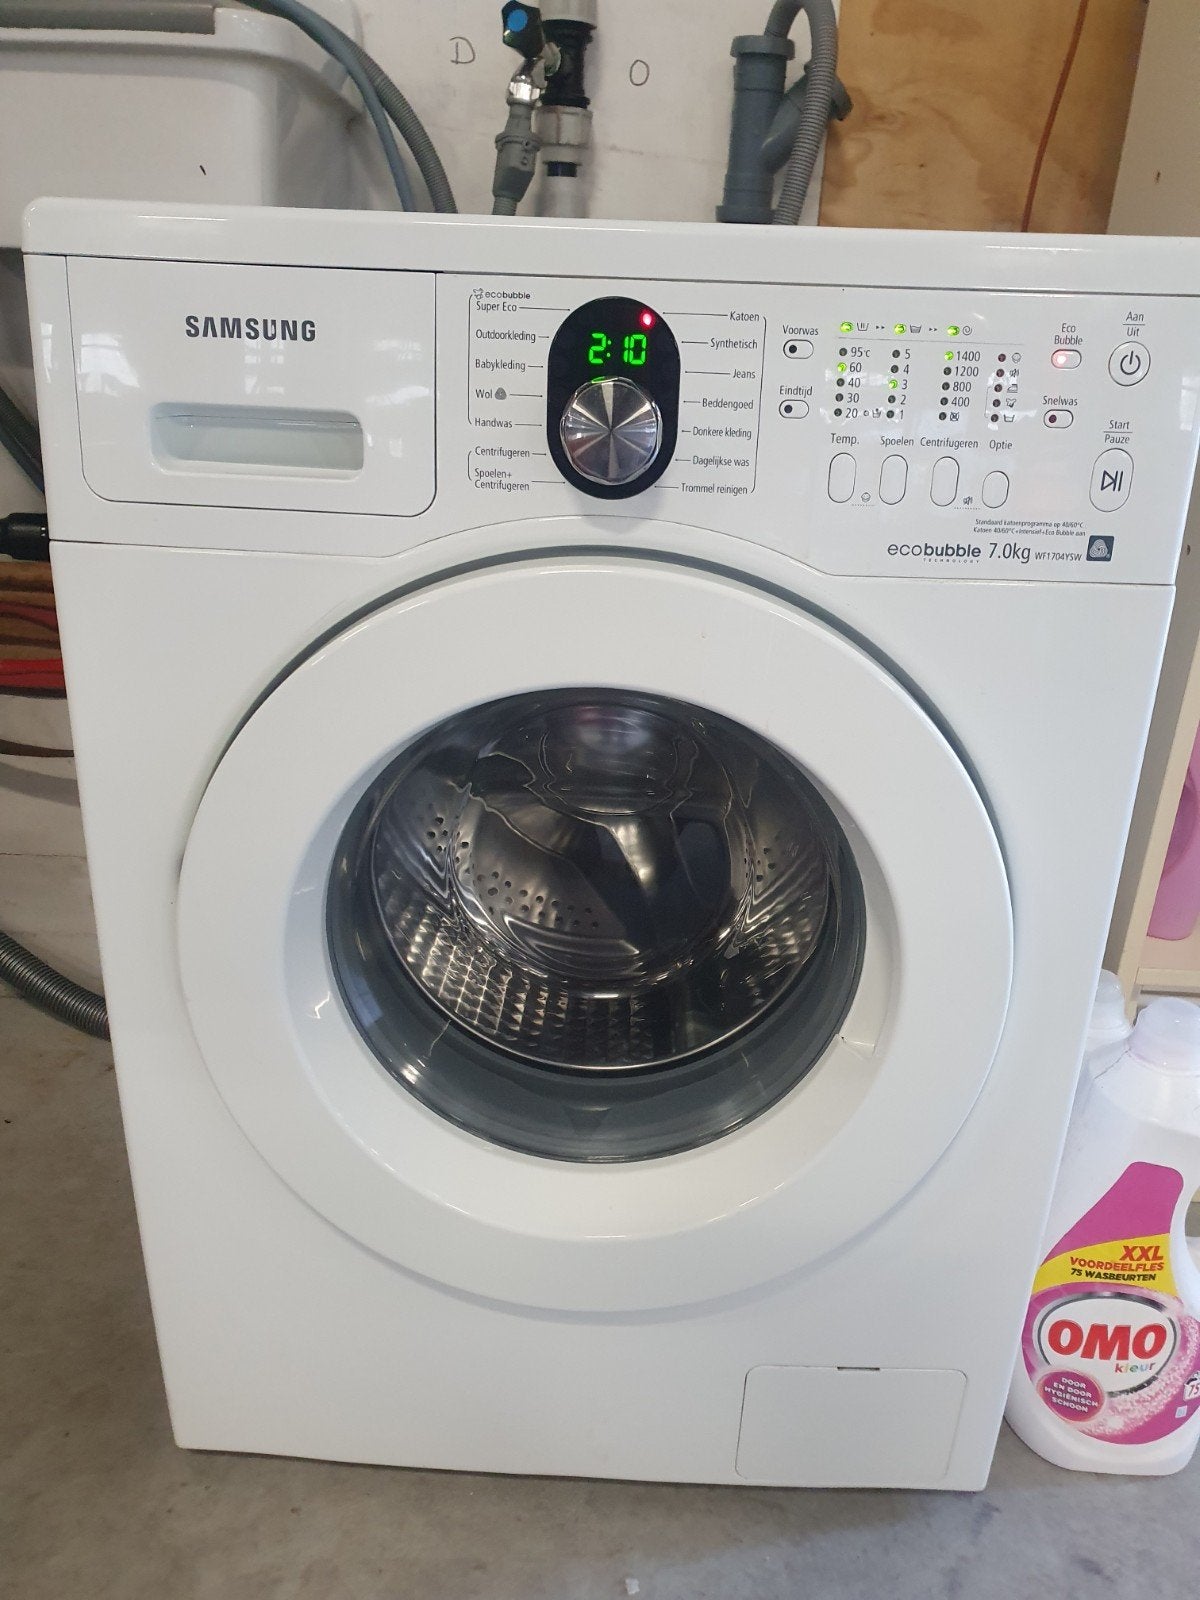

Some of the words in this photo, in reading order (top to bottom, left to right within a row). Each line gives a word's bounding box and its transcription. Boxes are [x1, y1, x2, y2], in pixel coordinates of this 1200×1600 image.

[449, 36, 476, 65] D
[484, 291, 531, 300] ecobubble
[476, 302, 499, 313] Super
[502, 303, 517, 312] Eco
[729, 311, 760, 322] Katoen
[1125, 312, 1145, 323] Aan
[185, 315, 316, 341] SAMSUNG
[783, 324, 819, 336] Voorwas
[1061, 323, 1076, 333] Eco
[1126, 327, 1140, 337] Uit
[475, 330, 536, 342] Outdoorkleding
[1054, 335, 1084, 346] Bubble
[588, 333, 647, 365] 2:10
[710, 338, 758, 350] Synthetisch
[904, 349, 911, 359] 5
[956, 351, 981, 362] 1400
[475, 360, 526, 372] Babykleding
[849, 362, 862, 373] 60
[903, 364, 910, 374] 4
[954, 366, 979, 377] 1200
[732, 368, 756, 379] Jeans
[848, 378, 861, 388] 40
[901, 379, 908, 390] 3
[952, 381, 972, 392] 800
[475, 389, 493, 399] Wol
[779, 385, 813, 398] Eindtijd
[847, 393, 860, 403] 30
[900, 395, 907, 405] 2
[951, 396, 970, 407] 400
[1042, 395, 1078, 406] Snelwas
[702, 398, 754, 411] Beddengoed
[845, 408, 858, 419] 20
[475, 418, 513, 429] Handwas
[1109, 420, 1130, 430] Start
[692, 426, 722, 438] Donkere
[723, 428, 752, 440] kleding
[830, 433, 860, 445] Temp.
[1104, 434, 1130, 444] Pauze
[880, 436, 914, 448] Spoelen
[920, 437, 979, 450] Centrifugeren
[989, 439, 1013, 451] Optie
[475, 446, 530, 459] Centrifugeren
[692, 456, 731, 468] Dagelijkse
[732, 459, 750, 468] was
[475, 468, 513, 480] Spoelen+
[474, 480, 530, 492] Centrifugeren
[681, 483, 715, 494] Trommel
[716, 484, 748, 496] reinigen
[887, 543, 982, 557] ecobubble
[989, 542, 1032, 564] 7.0kg
[1034, 551, 1082, 562] WF1704YSW
[1119, 1245, 1164, 1262] XXL
[1070, 1256, 1165, 1272] VOORDEELFLES
[1070, 1268, 1083, 1277] 75
[1085, 1270, 1157, 1282] WASBEURTEN
[1047, 1318, 1167, 1361] OMO
[1114, 1360, 1156, 1375] kleur
[1061, 1377, 1087, 1389] DOOR
[1053, 1382, 1065, 1391] EN
[1067, 1386, 1092, 1398] DOOR
[1052, 1396, 1089, 1413] SCHOON
